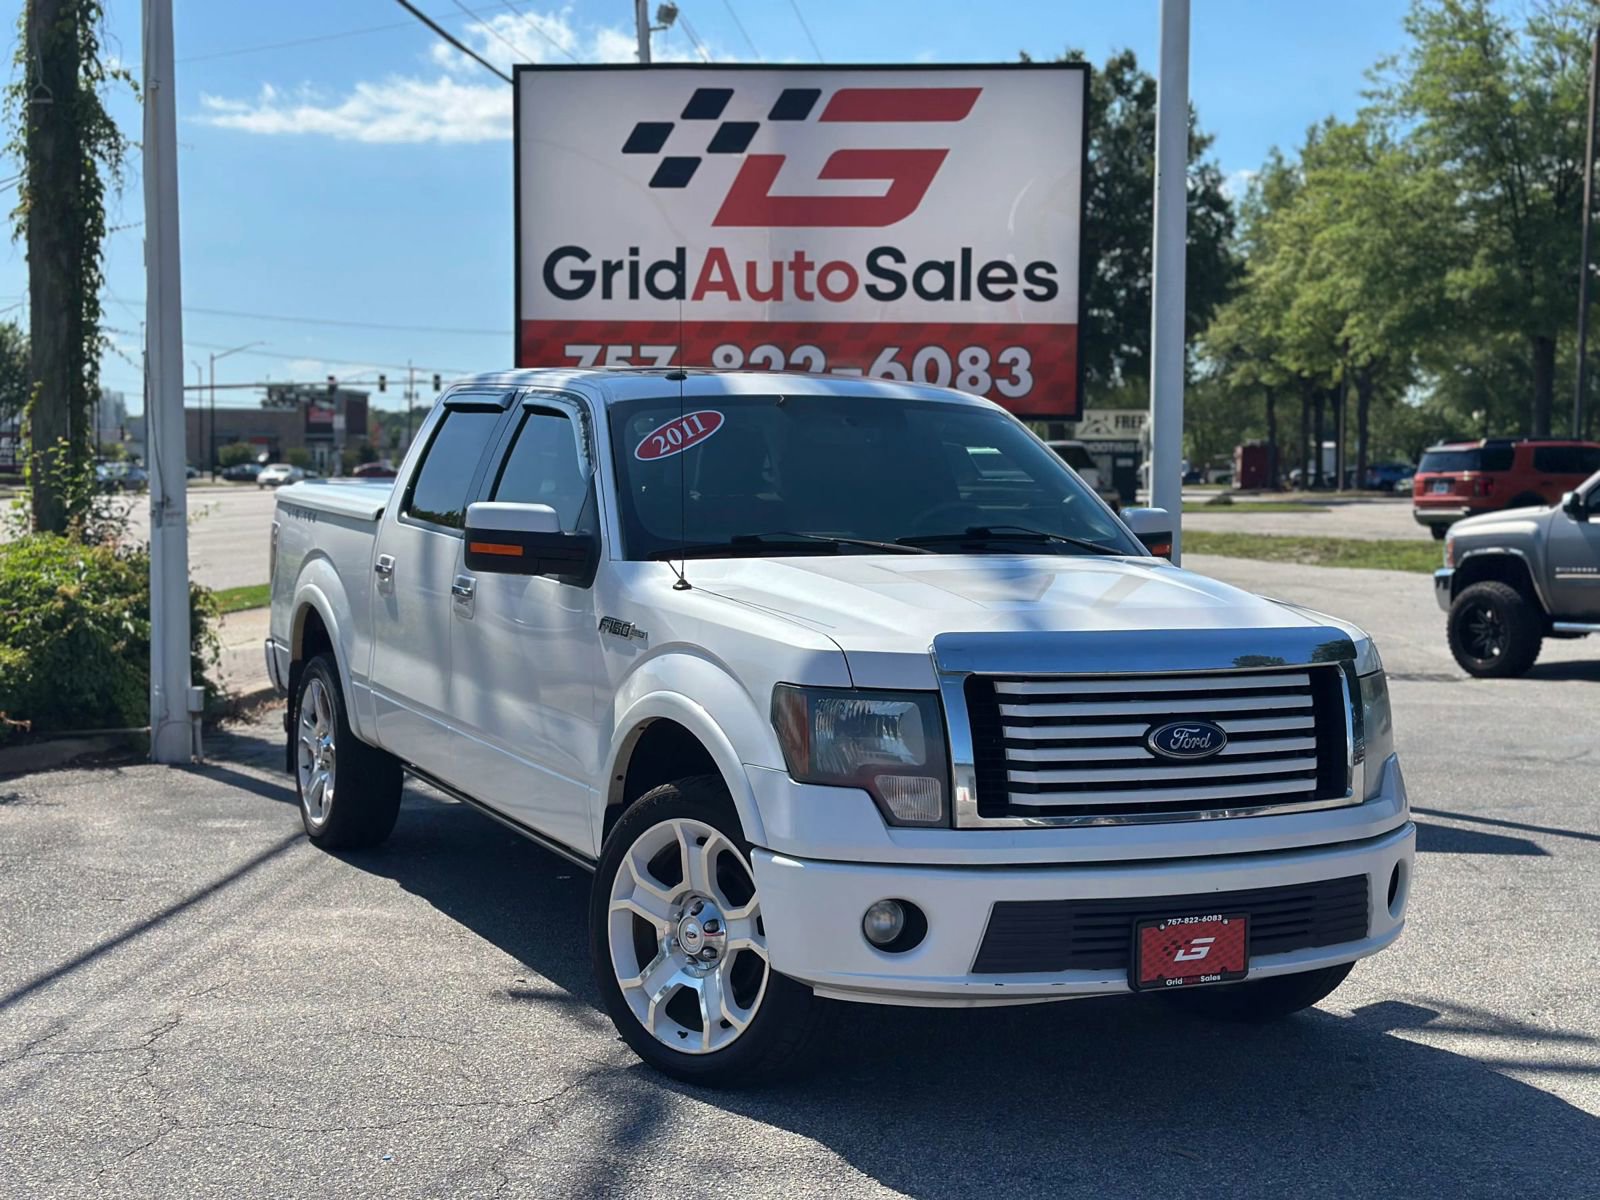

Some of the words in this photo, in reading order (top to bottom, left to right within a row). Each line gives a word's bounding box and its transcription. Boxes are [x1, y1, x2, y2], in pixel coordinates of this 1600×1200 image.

[564, 345, 1034, 398] 757822-6083
[652, 415, 707, 454] 2011
[1170, 728, 1211, 750] Ford
[1167, 914, 1222, 926] 757-822-6083
[1166, 978, 1183, 986] Grid
[1200, 974, 1221, 983] Sales
